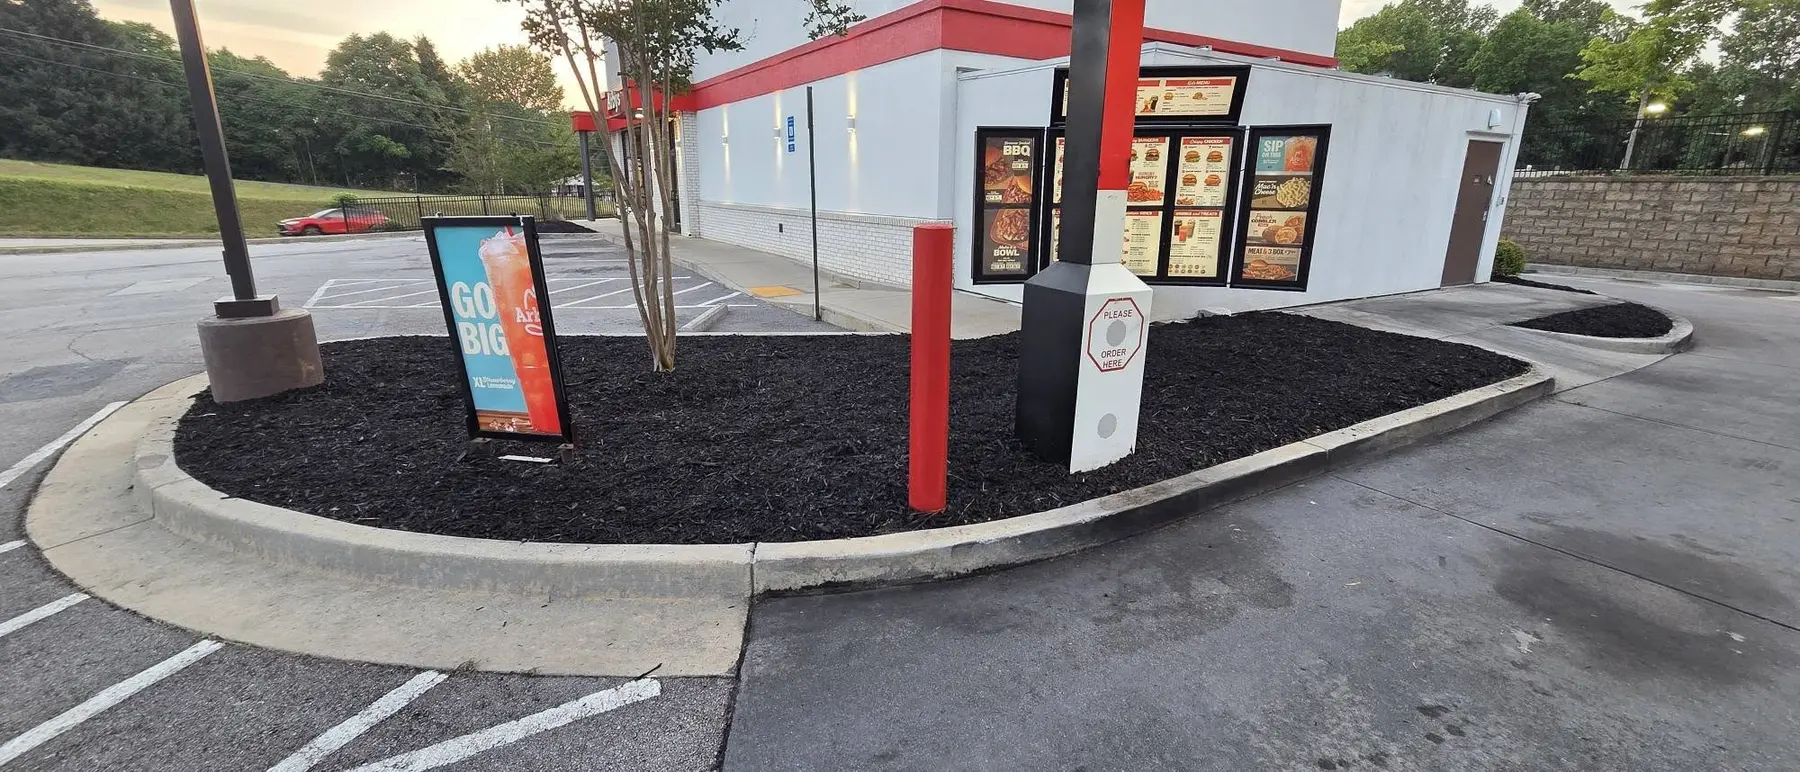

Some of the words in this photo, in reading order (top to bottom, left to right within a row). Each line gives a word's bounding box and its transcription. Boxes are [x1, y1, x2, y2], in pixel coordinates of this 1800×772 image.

[1003, 145, 1031, 157] BBQ
[1264, 140, 1284, 152] SIP
[993, 249, 1020, 257] BOWL
[1248, 247, 1263, 255] MEAT
[451, 281, 496, 319] GO
[1103, 310, 1133, 319] PLEASE
[458, 321, 510, 356] BIG
[1101, 349, 1126, 358] ORDER
[1102, 359, 1123, 368] HERE
[472, 376, 486, 388] XL
